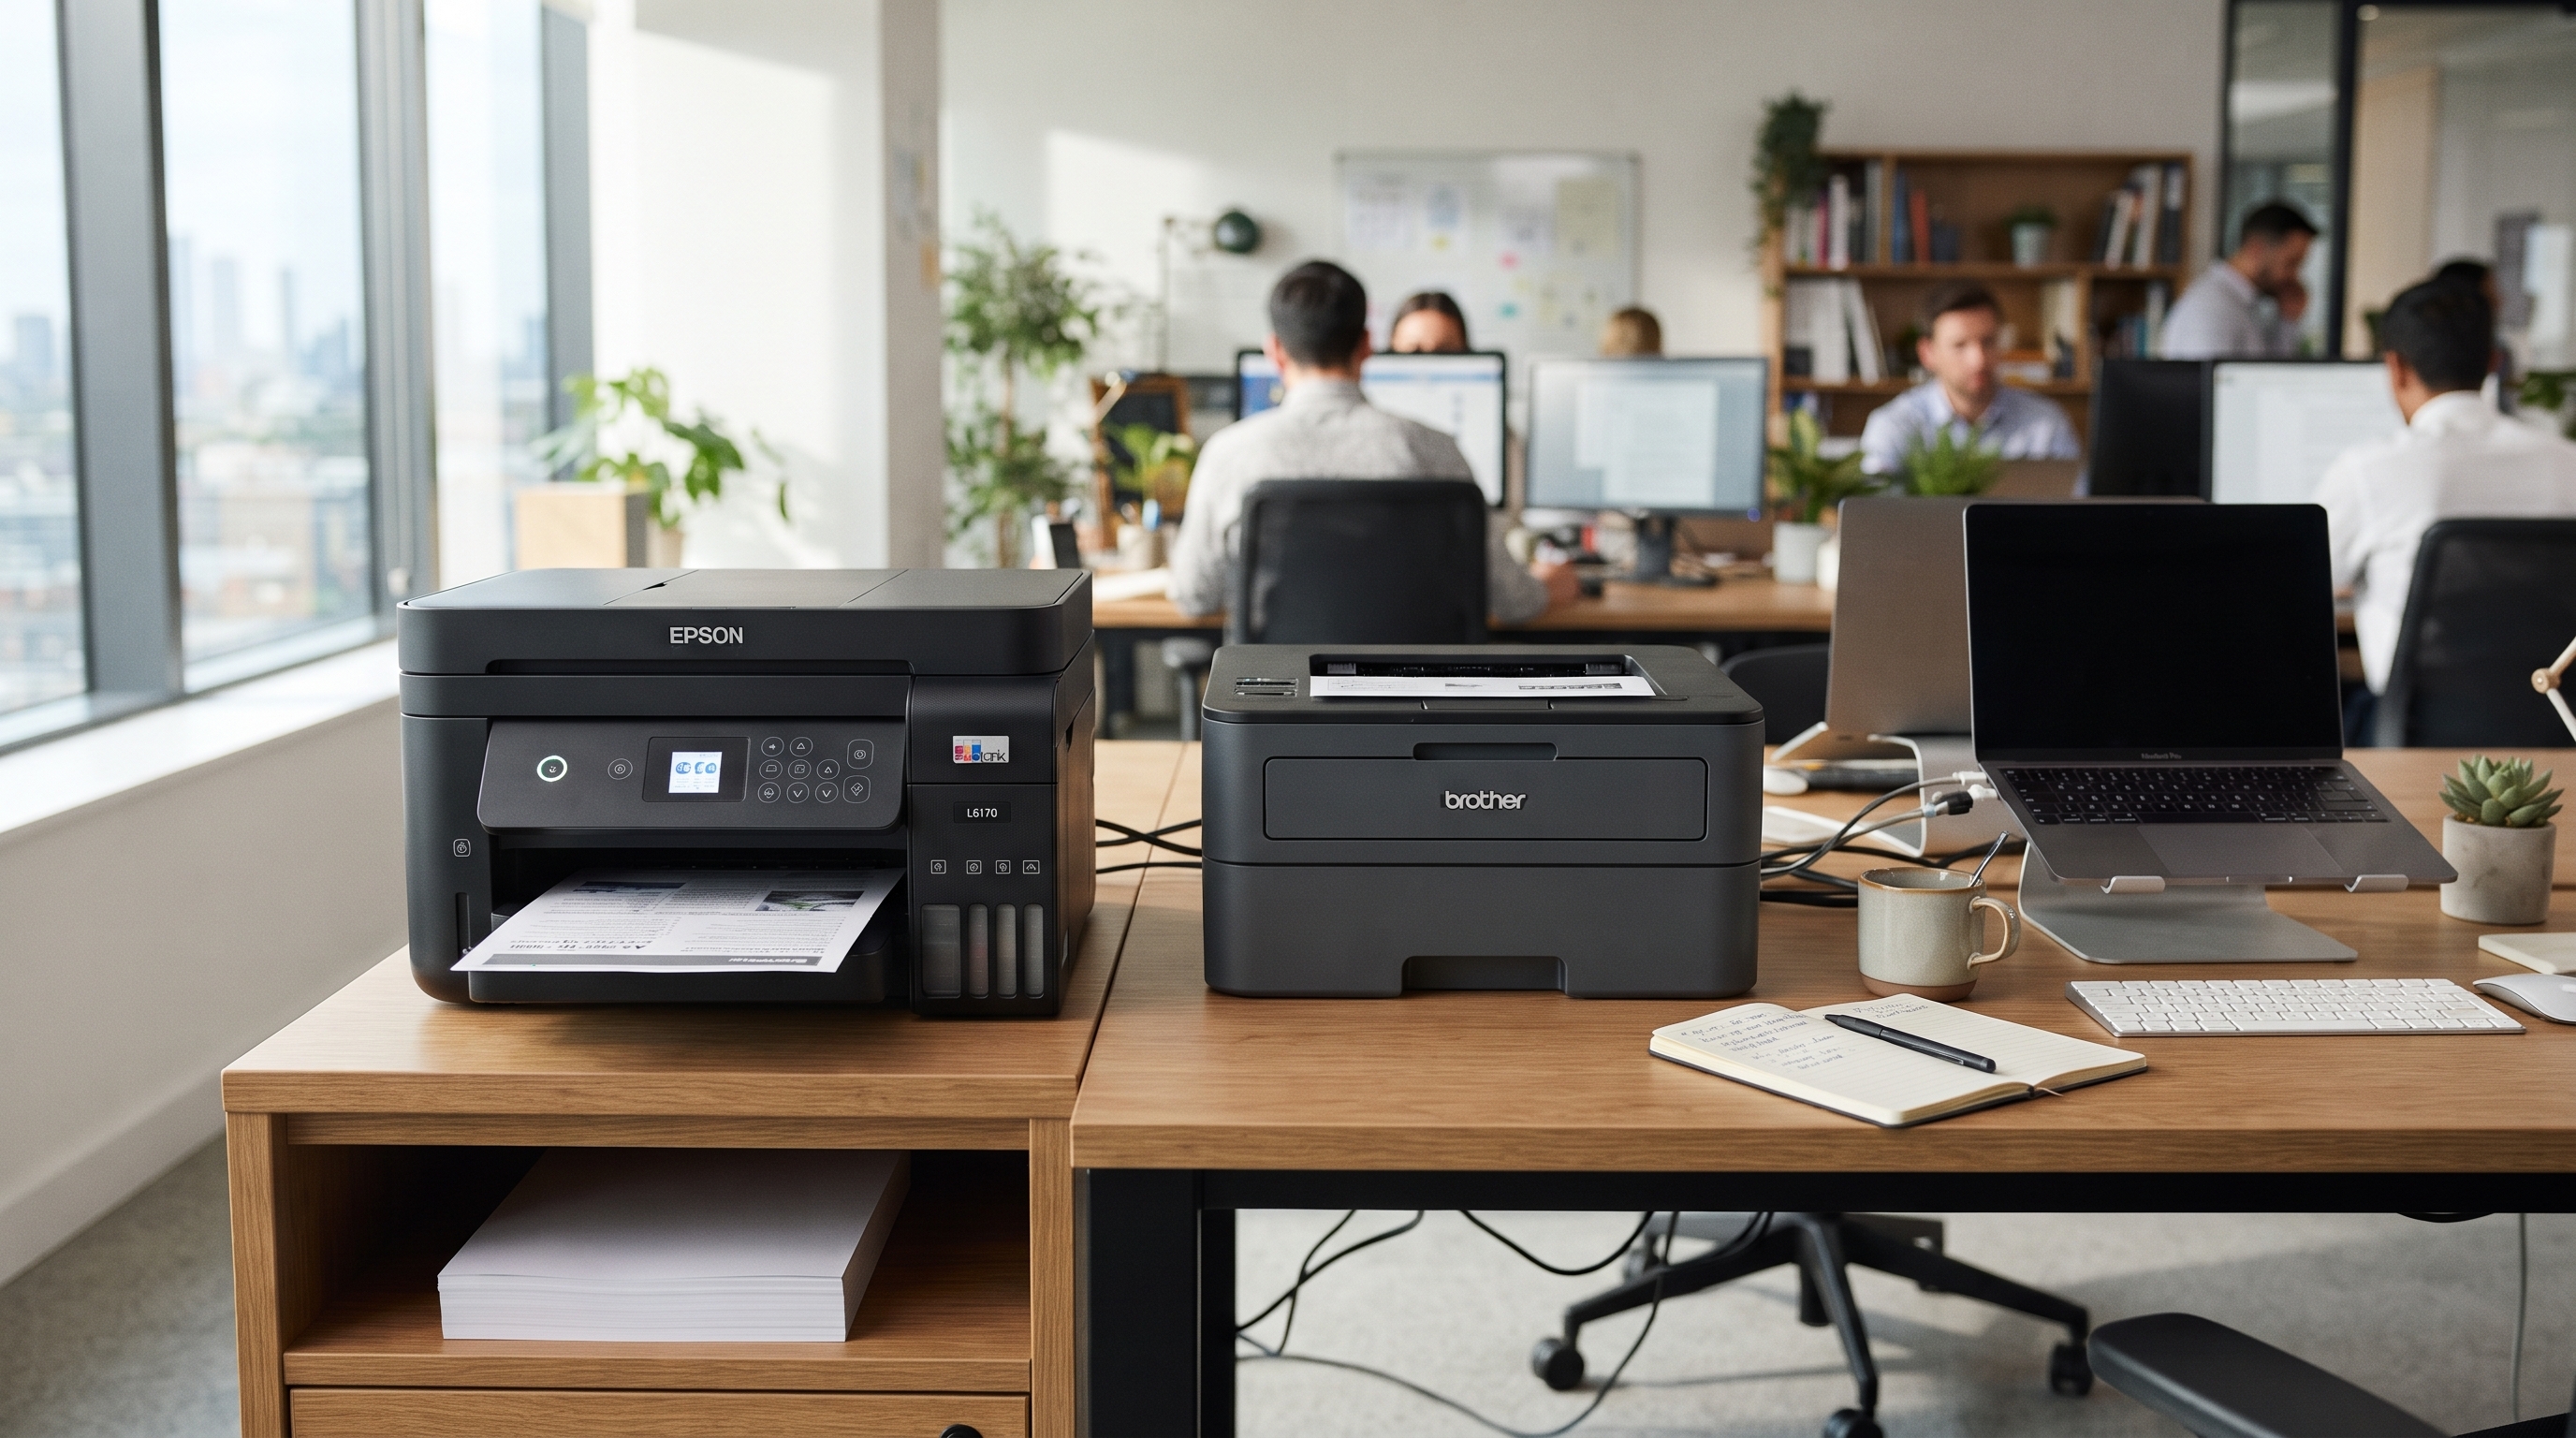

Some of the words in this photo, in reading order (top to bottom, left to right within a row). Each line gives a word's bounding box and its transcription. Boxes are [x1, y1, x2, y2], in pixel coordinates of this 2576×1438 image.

[669, 626, 743, 644] EPSON
[1444, 790, 1527, 810] brother
[967, 808, 998, 818] L6170
